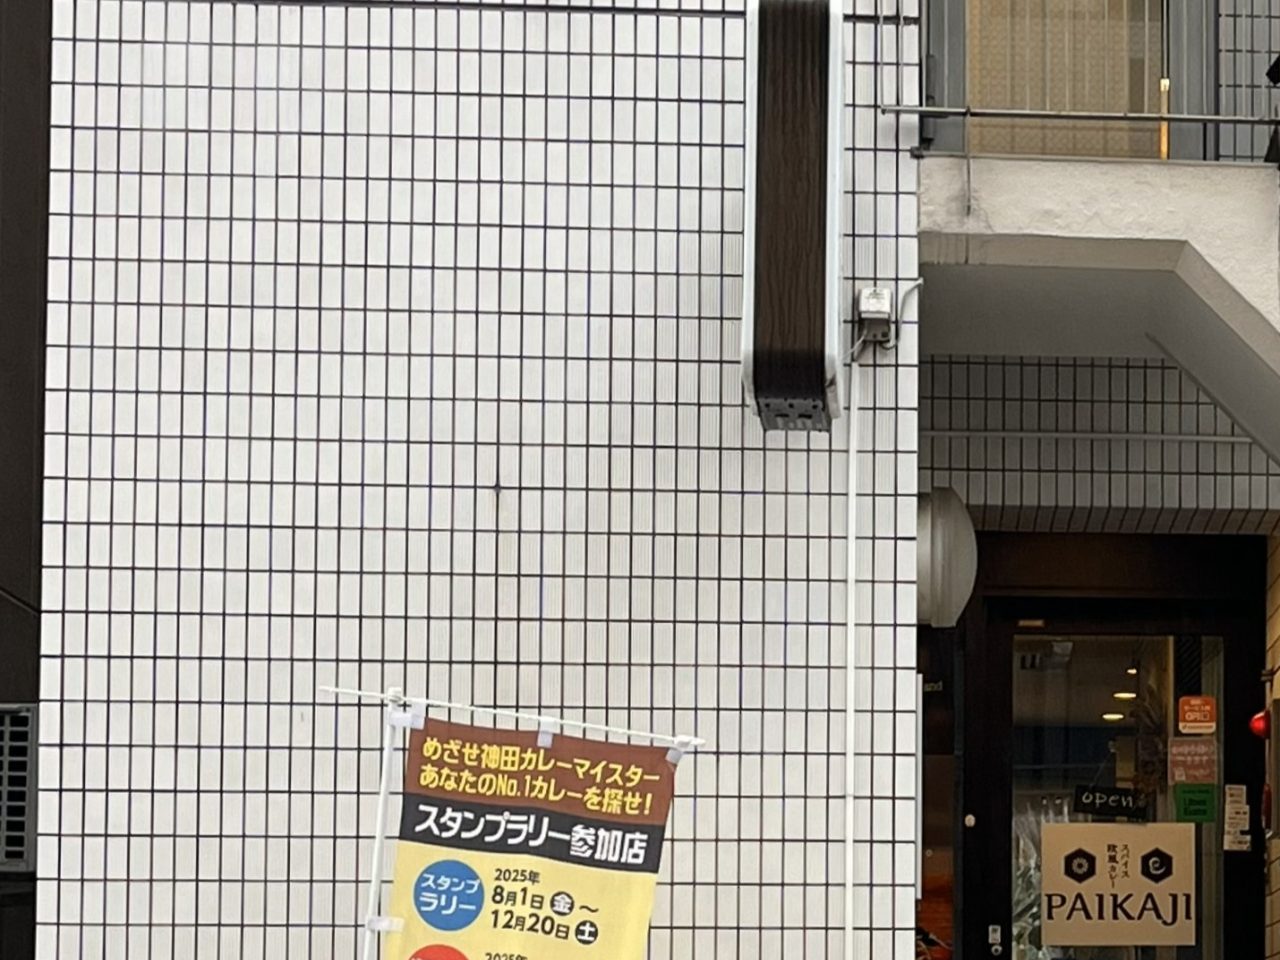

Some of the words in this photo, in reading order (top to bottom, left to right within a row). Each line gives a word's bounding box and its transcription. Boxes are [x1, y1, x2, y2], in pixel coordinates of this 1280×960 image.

[422, 737, 660, 784] めざせ神田カレーマイスター
[414, 804, 649, 864] スタンプラリー参加店
[421, 873, 480, 894] スタンプ
[494, 868, 540, 885] 2025年
[419, 892, 477, 914] ラリー
[1045, 892, 1192, 926] PAIKAJI
